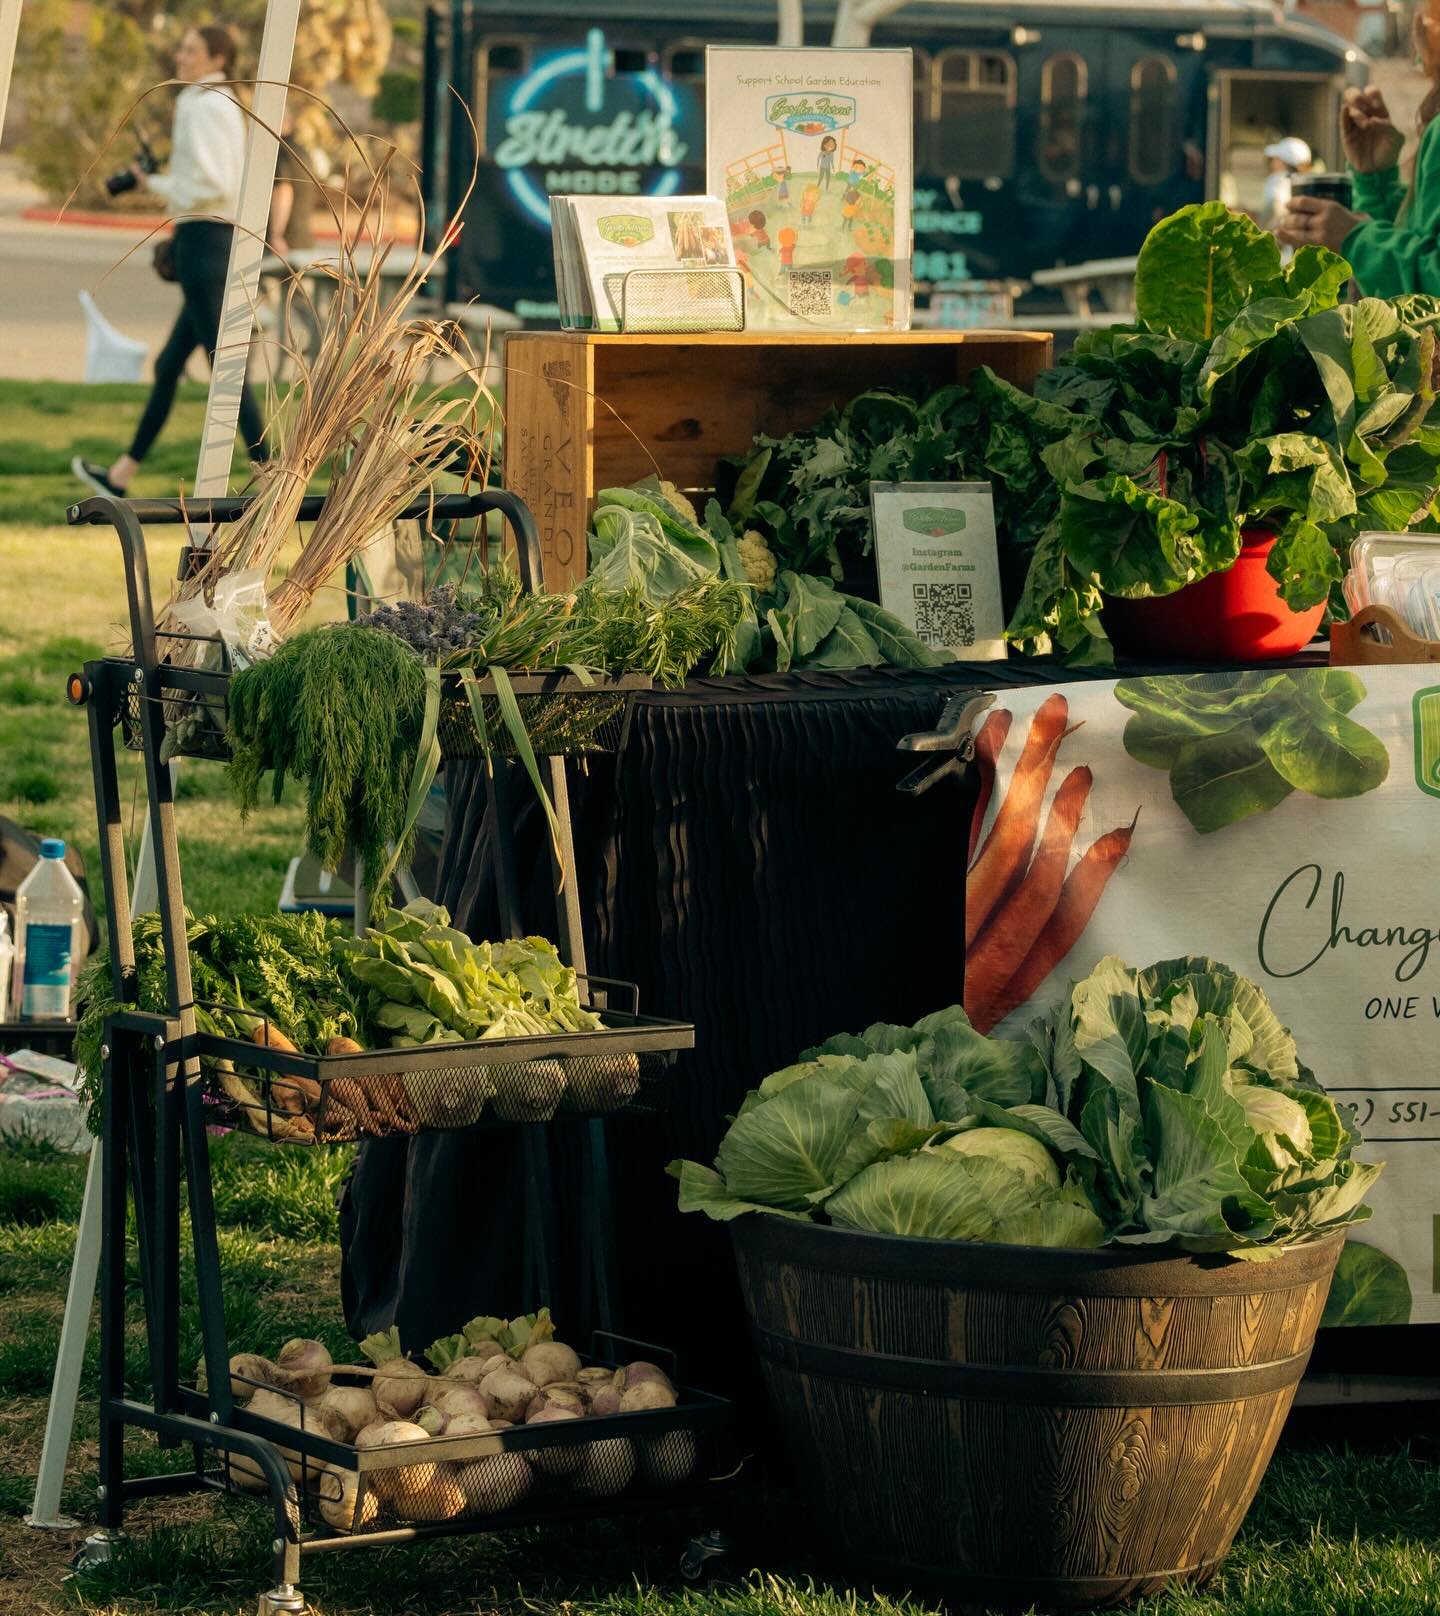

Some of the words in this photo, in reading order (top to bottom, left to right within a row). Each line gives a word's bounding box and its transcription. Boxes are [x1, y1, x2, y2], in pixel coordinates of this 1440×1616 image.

[737, 74, 772, 87] Support
[775, 74, 803, 86] School
[806, 75, 836, 86] Garden
[839, 74, 881, 87] Education
[495, 108, 688, 168] Stretch
[545, 170, 641, 194] MODE
[543, 433, 554, 560] GRANDE
[553, 437, 574, 567] VEO
[912, 547, 963, 558] Instagram
[901, 562, 977, 572] @GardenFarms
[1257, 863, 1440, 982] Chang
[1364, 996, 1420, 1020] ONE
